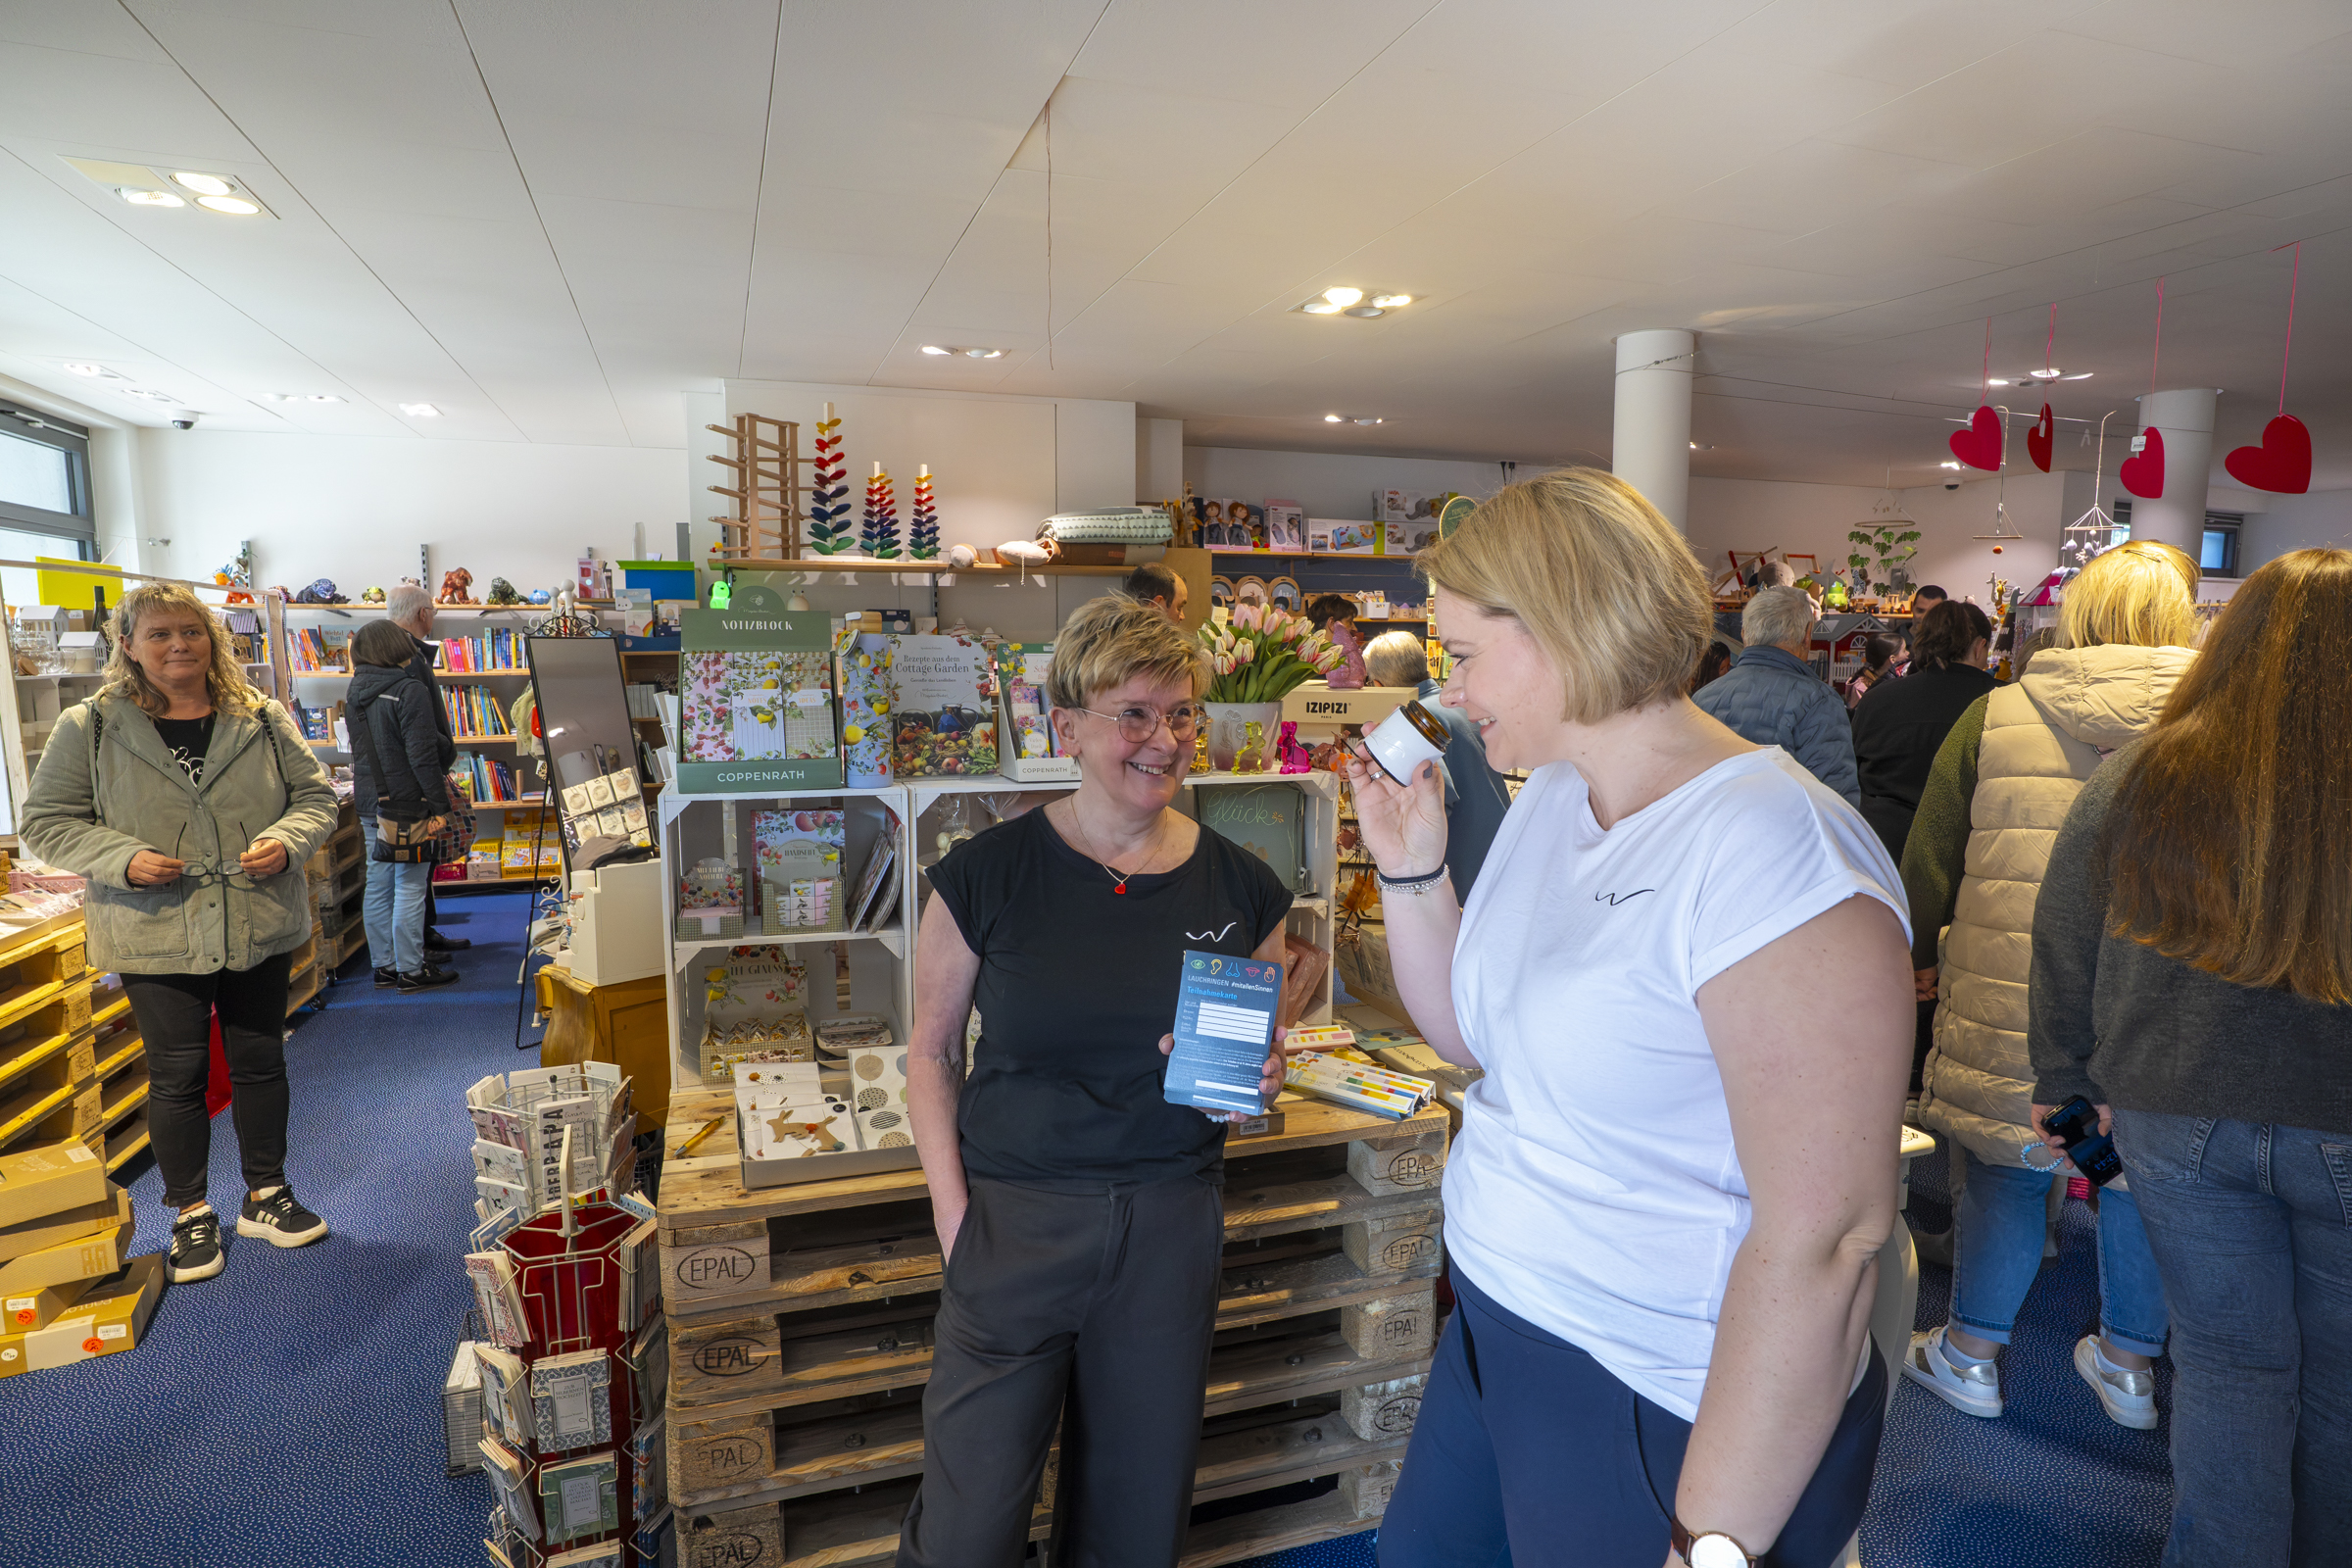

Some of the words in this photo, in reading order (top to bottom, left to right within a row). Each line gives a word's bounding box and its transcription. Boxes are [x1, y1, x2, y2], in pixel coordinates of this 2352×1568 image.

[721, 619, 794, 631] NOTIZBLOCK
[904, 654, 931, 664] Rezepte
[895, 662, 932, 676] Cottage
[934, 662, 969, 673] Garden
[1305, 701, 1348, 714] IZIPIZI
[716, 769, 805, 782] COPPENRATH
[1204, 790, 1277, 833] Glück
[1187, 974, 1230, 987] LAUCHRINGEN
[1231, 981, 1273, 993] #mitallenSinnen
[1187, 985, 1238, 1001] Teilnahmekarte
[690, 1255, 745, 1283] EPAL
[703, 1346, 759, 1370] EPAL
[697, 1445, 753, 1470] PAL
